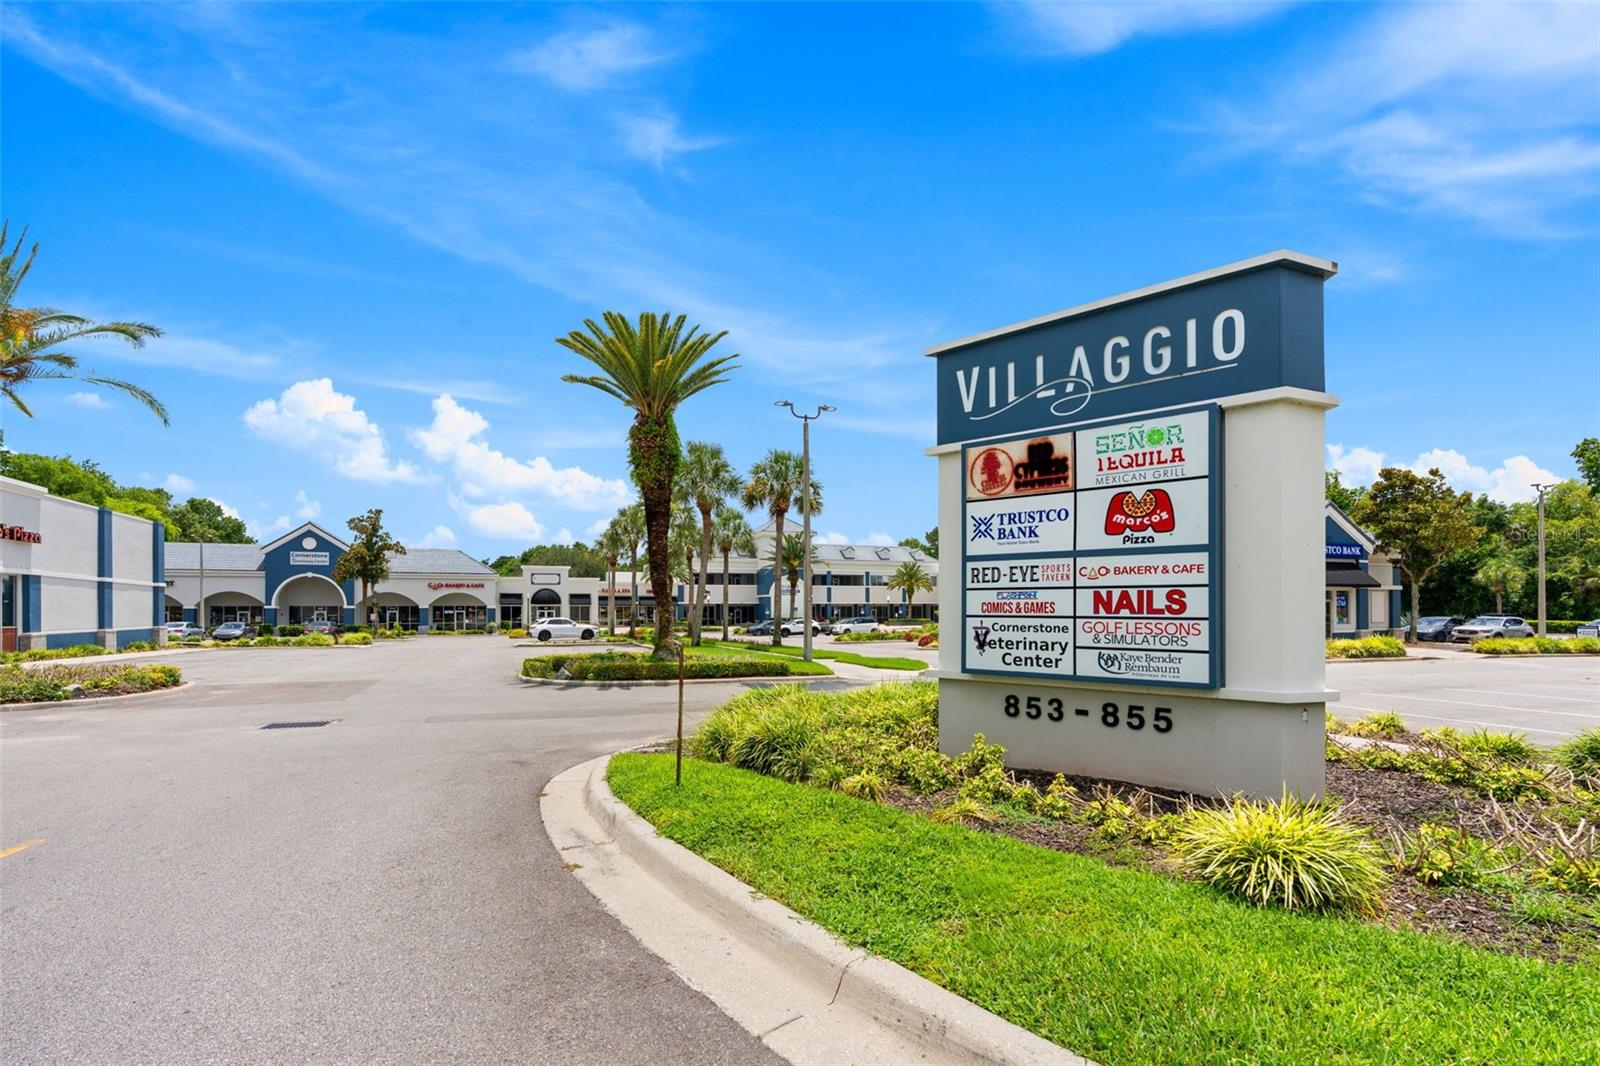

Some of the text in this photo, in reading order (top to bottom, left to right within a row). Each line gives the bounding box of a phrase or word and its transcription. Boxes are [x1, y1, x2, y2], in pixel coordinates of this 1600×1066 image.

[956, 308, 1246, 413] VILLAGGIO
[1095, 467, 1186, 485] MEXICAN GRILL
[997, 507, 1070, 526] TRUSTCO
[997, 525, 1040, 540] BANK
[1342, 546, 1362, 555] BANK
[970, 565, 1040, 584] RED-EYE
[1041, 563, 1071, 573] SPORTS
[1113, 565, 1160, 576] BAKERY
[1161, 564, 1170, 574] &
[1172, 563, 1205, 574] CAFE
[1041, 573, 1071, 582] TAVERN
[981, 601, 1056, 614] COMICS & GAMES
[1092, 588, 1188, 615] NAILS
[991, 622, 1070, 634] Cornerstone
[1081, 621, 1202, 637] GOLF LESSONS
[973, 630, 1069, 656] Veterinary
[1092, 633, 1189, 647] & SIMULATORS
[1001, 652, 1063, 669] Center
[1120, 652, 1184, 665] Kaye Bender
[1124, 662, 1181, 675] Rembaum
